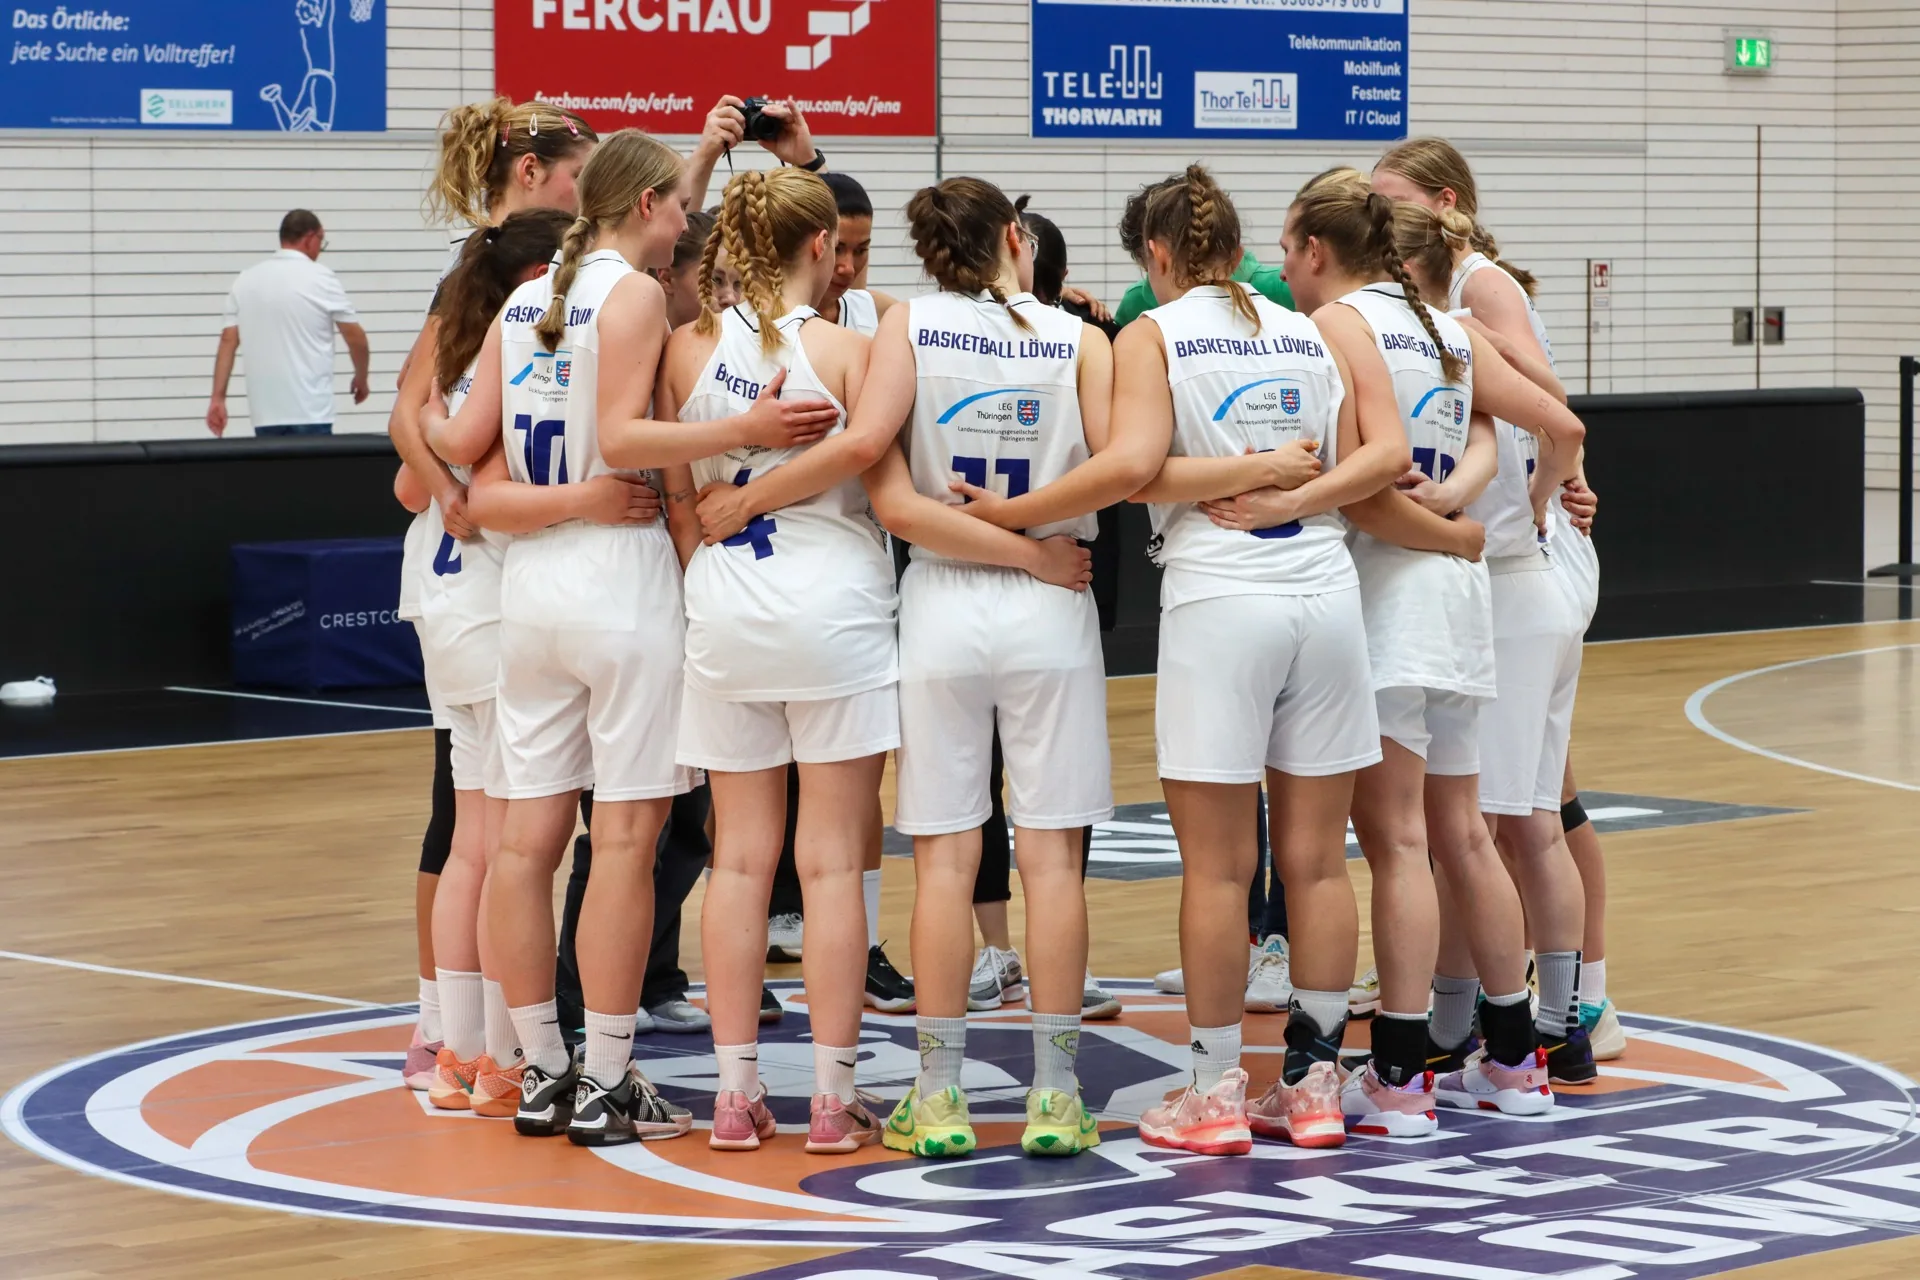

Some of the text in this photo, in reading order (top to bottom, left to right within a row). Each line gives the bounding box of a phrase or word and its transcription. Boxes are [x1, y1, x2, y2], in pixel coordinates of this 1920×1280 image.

[12, 6, 130, 31] Das Örtliche:
[532, 0, 771, 34] FERCHAU
[1288, 33, 1401, 52] Telekommunikation
[10, 41, 235, 68] jede Suche ein Volltreffer!
[1344, 60, 1401, 76] Mobilfunk
[1352, 85, 1401, 101] Festnetz
[1042, 107, 1162, 126] THORWARTH
[1345, 110, 1357, 125] IT
[1366, 110, 1401, 126] Cloud
[918, 328, 1074, 359] BASKETBALL LÖWEN
[1175, 335, 1324, 358] BASKETBALL LÖWEN
[977, 410, 1012, 422] Thüringen
[998, 402, 1013, 411] LEG
[952, 455, 1031, 504] 11
